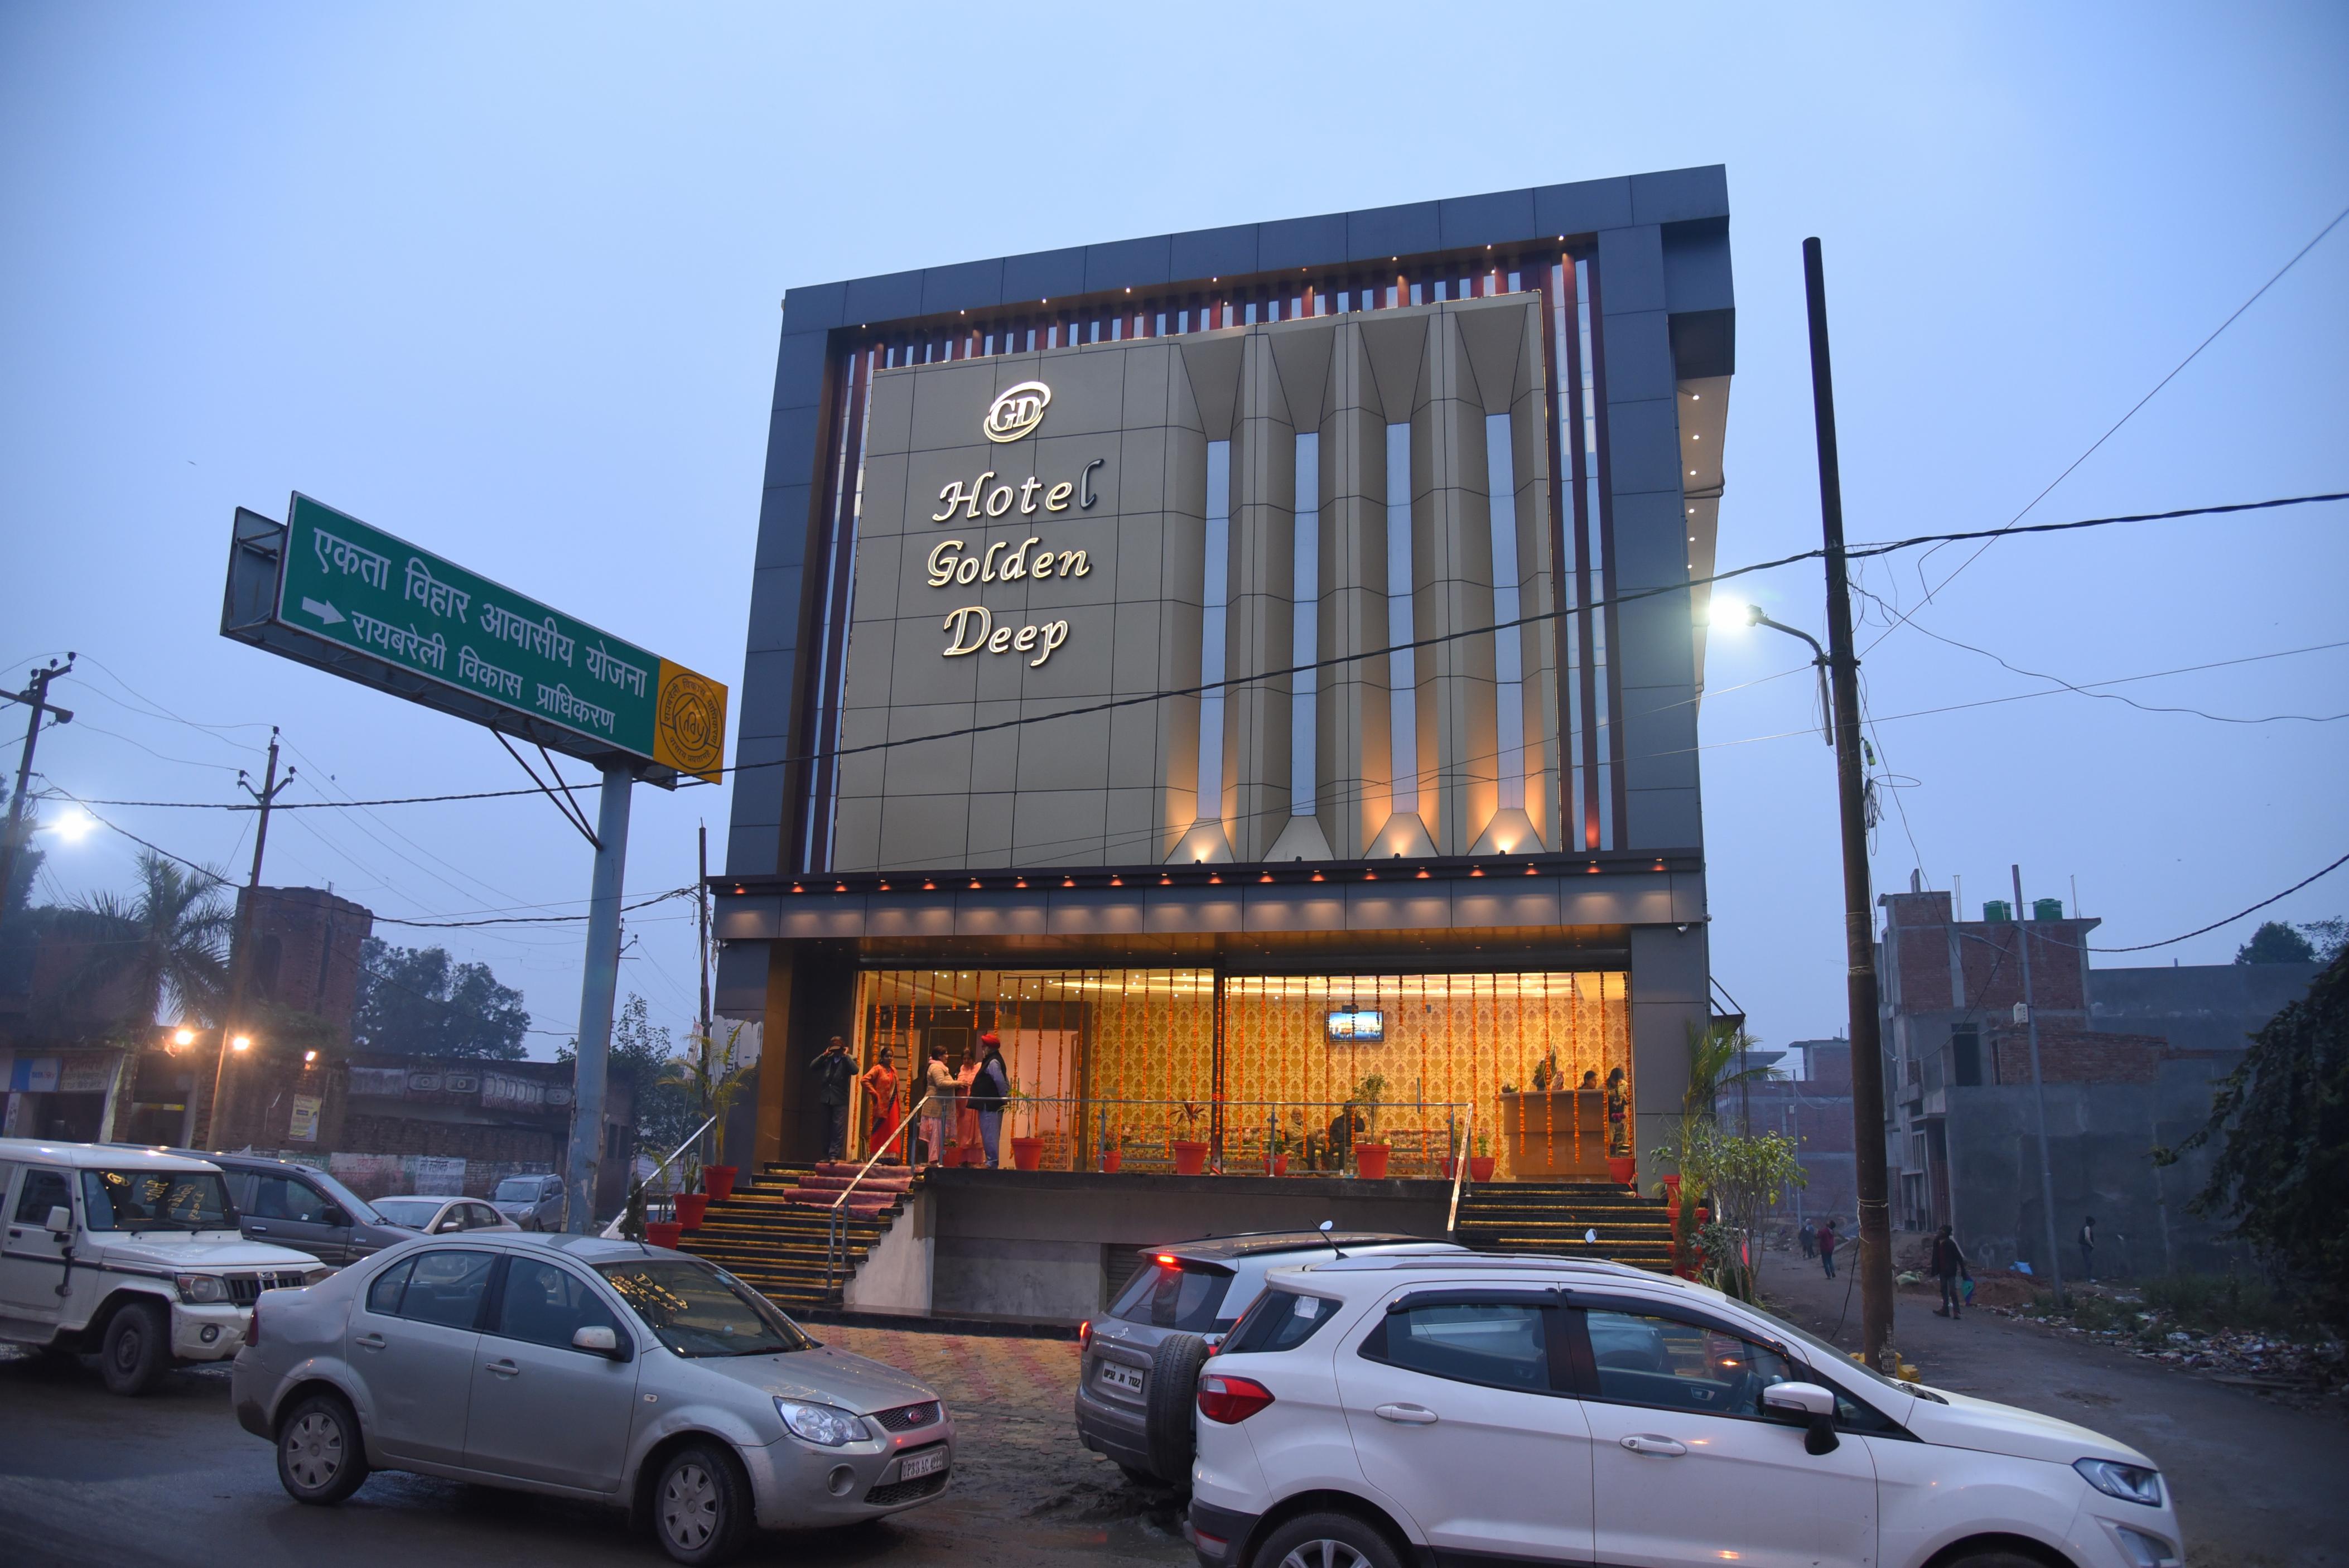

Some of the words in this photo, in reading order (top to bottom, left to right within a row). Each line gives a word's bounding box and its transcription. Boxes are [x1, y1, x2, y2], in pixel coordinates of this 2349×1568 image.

[989, 396, 1041, 432] GD
[932, 459, 1104, 521] Hotel
[927, 537, 1092, 587] Golden
[313, 527, 392, 590] एकता
[405, 557, 471, 624] विहार
[480, 603, 575, 668] आवासीय
[586, 639, 648, 698] योजना
[942, 606, 1069, 667] Deep
[351, 610, 447, 670] रायबरेली
[458, 645, 523, 699] विकास
[536, 683, 616, 735] प्राधिकरण
[682, 678, 706, 696] विकास
[1104, 1369, 1116, 1380] UP32
[904, 1461, 919, 1477] UP33
[921, 1459, 929, 1473] AC
